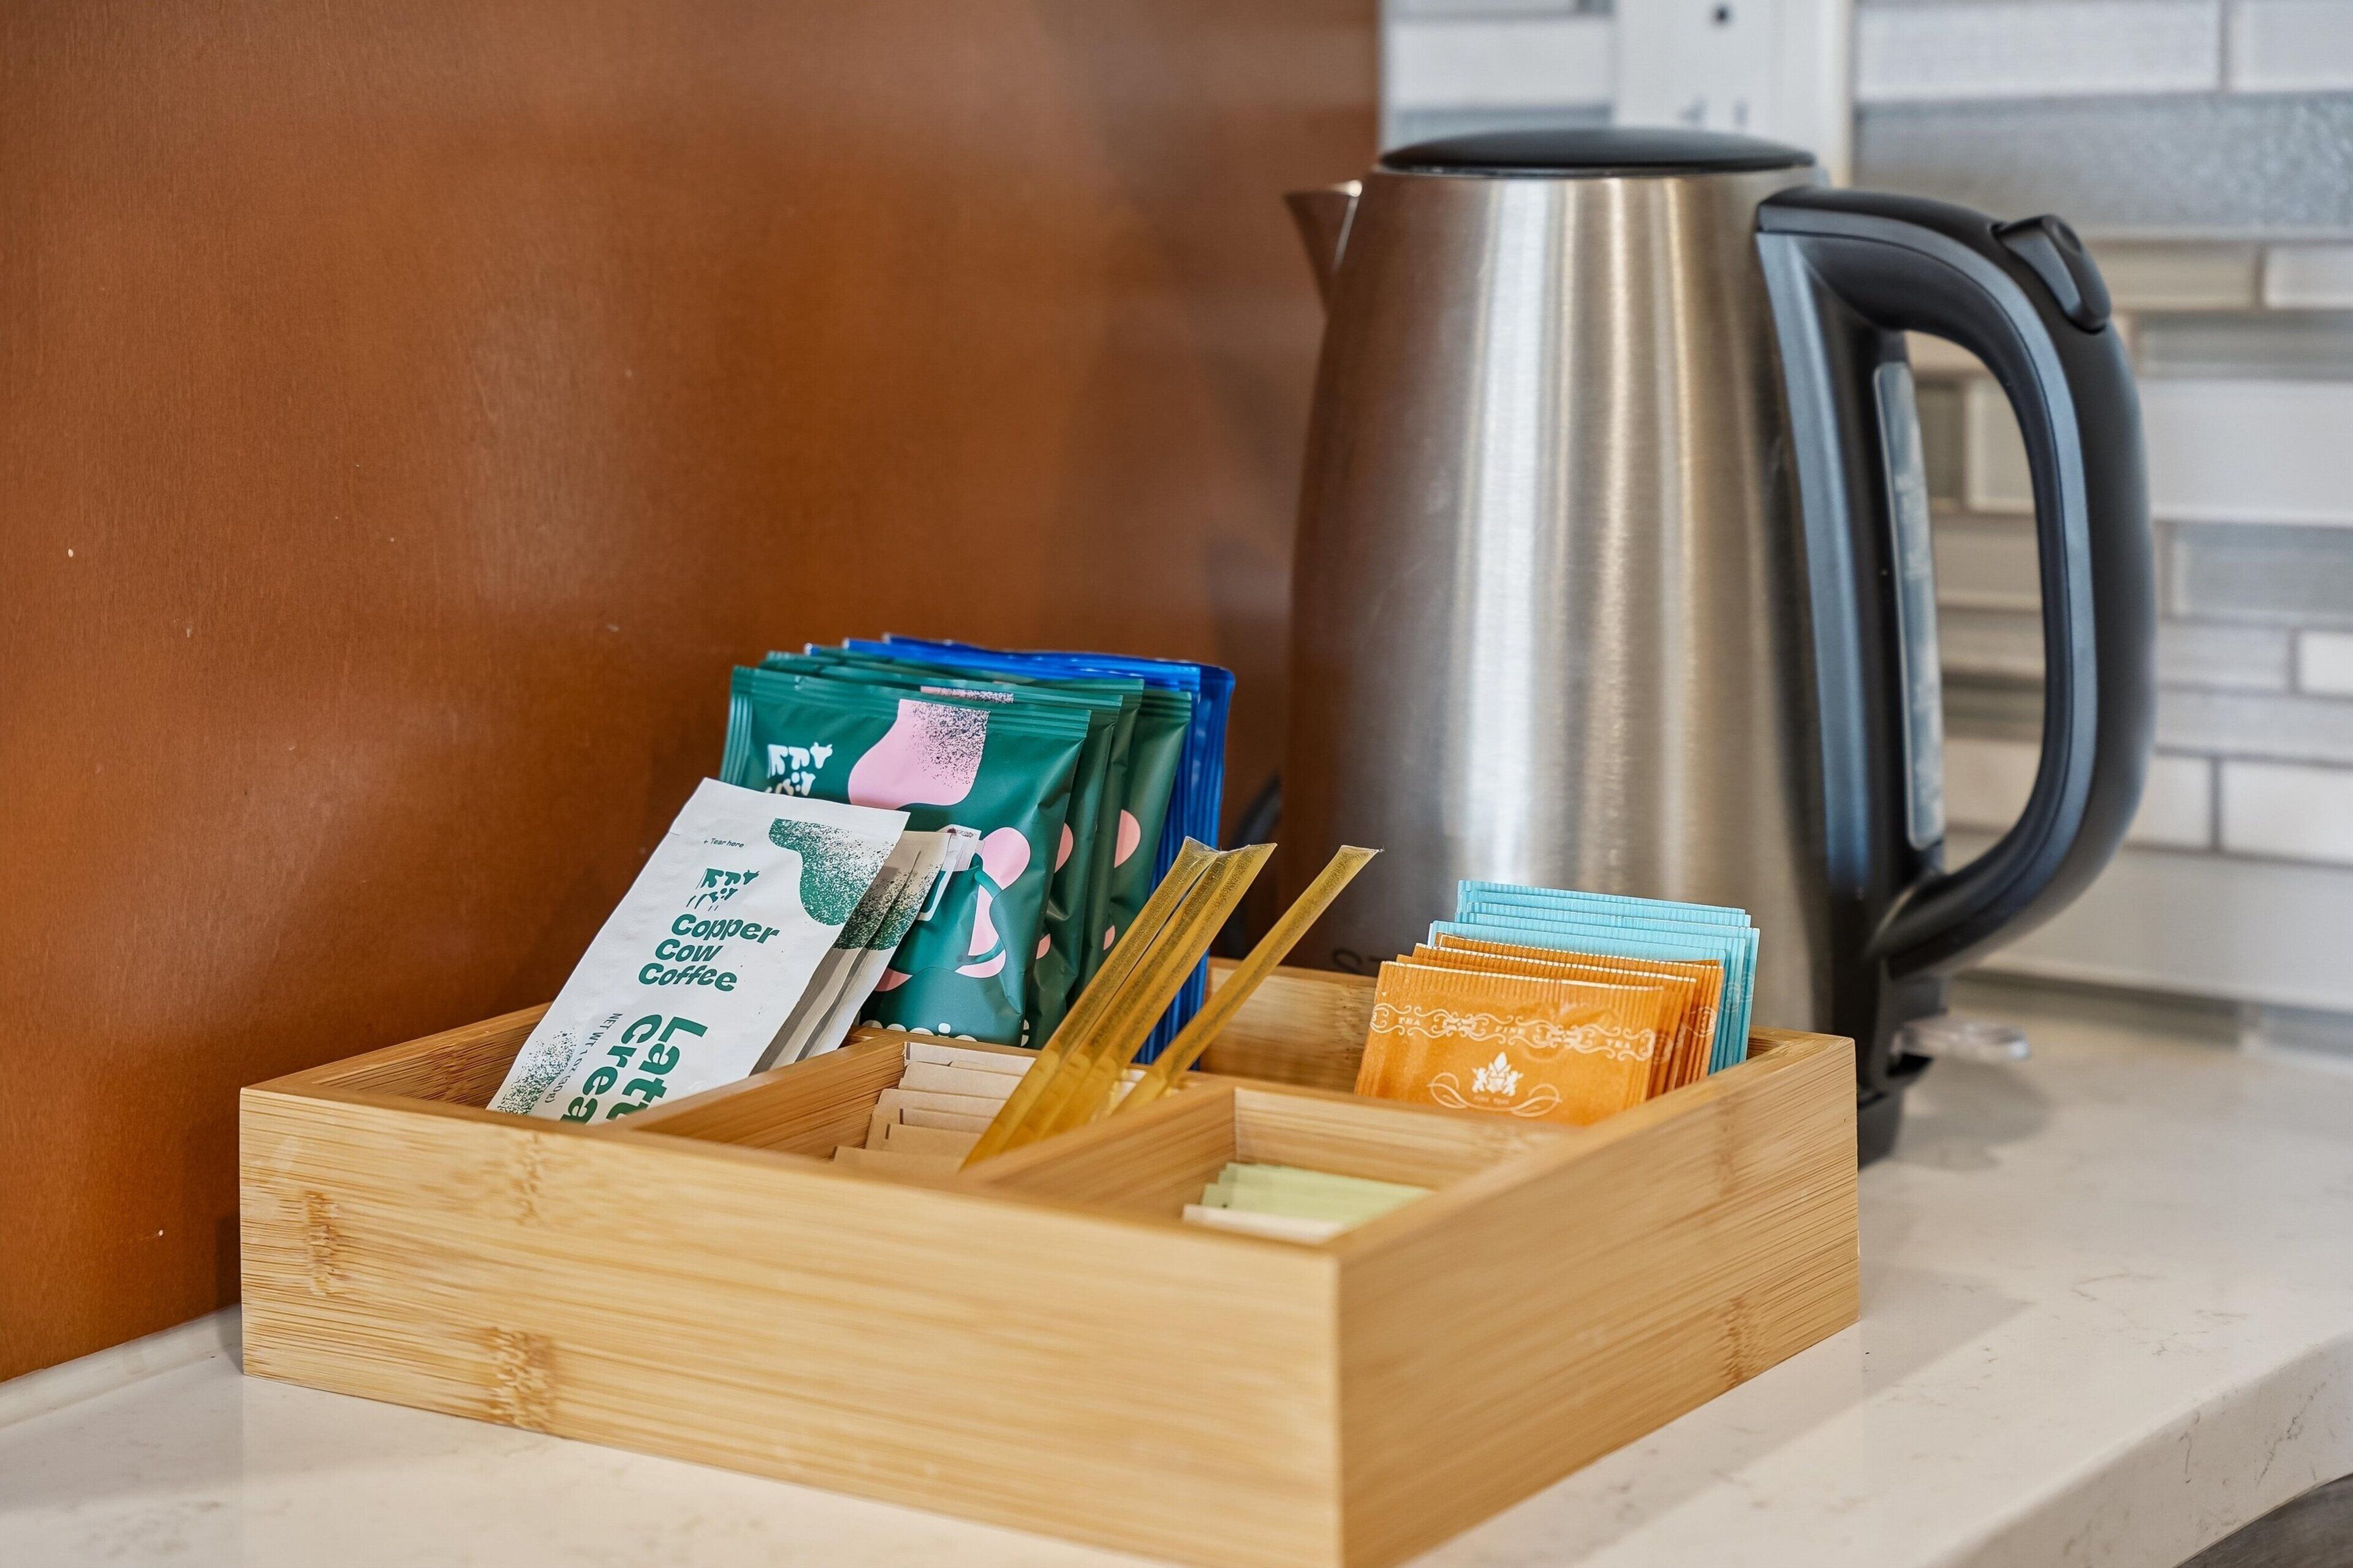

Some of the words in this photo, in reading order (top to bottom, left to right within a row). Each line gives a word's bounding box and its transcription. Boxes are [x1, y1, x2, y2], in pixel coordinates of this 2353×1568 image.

[726, 839, 745, 848] here
[671, 914, 780, 944] Copper
[655, 939, 724, 962] Cow
[638, 963, 737, 991] Coffee
[599, 1013, 623, 1030] NET
[585, 1032, 604, 1047] WT
[568, 1058, 583, 1073] OZ
